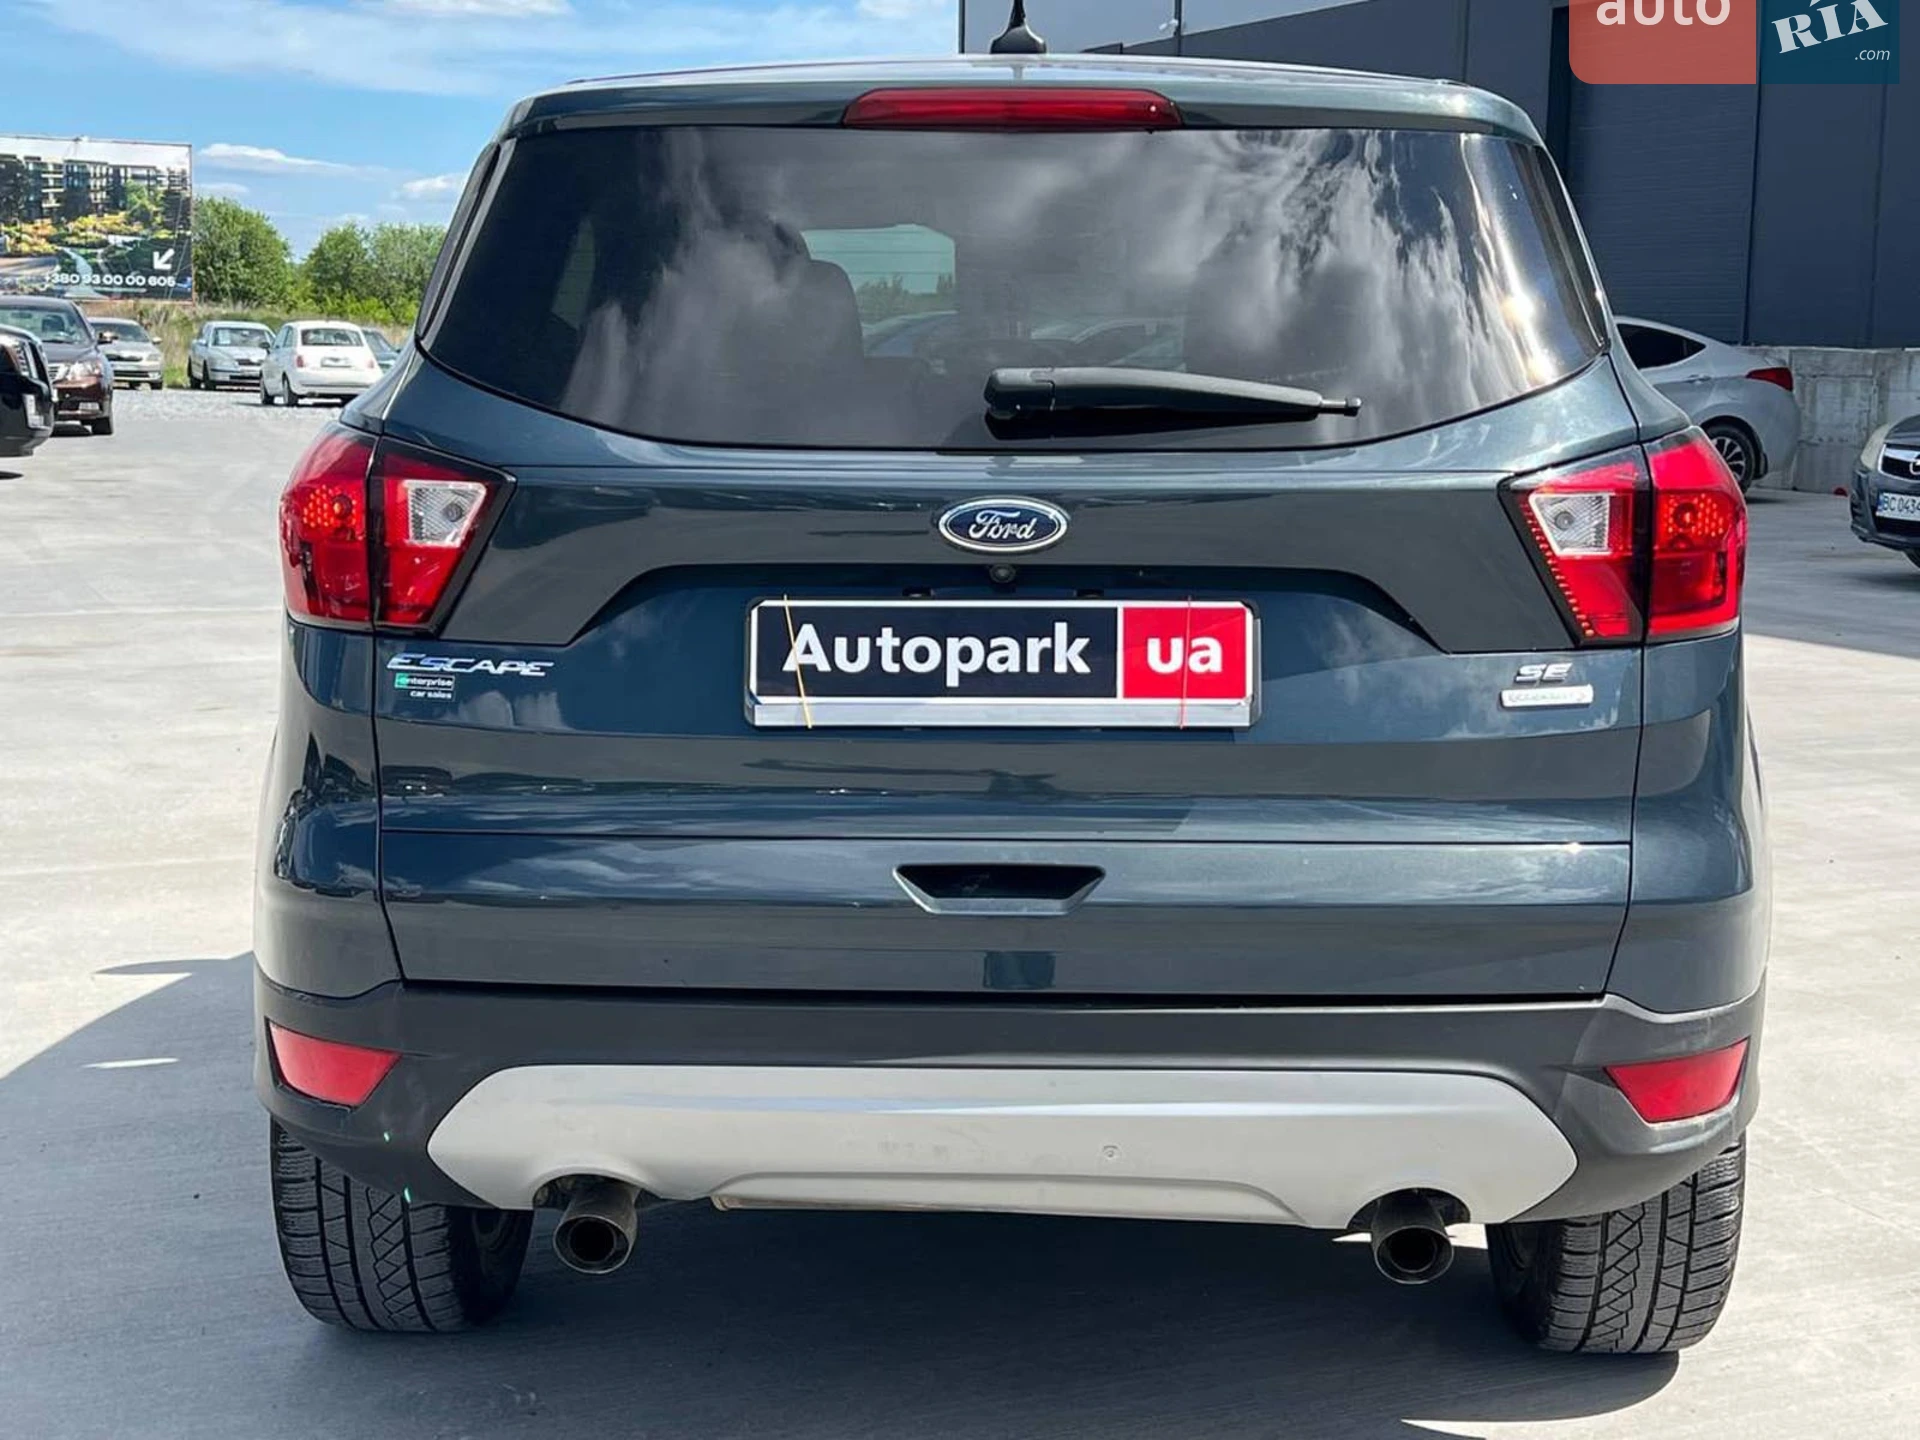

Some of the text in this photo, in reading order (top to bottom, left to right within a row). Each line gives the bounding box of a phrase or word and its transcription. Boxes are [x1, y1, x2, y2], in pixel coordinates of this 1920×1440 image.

[102, 274, 124, 286] 00
[125, 275, 146, 287] 00
[968, 509, 1037, 539] Ford
[386, 652, 554, 676] ESCAPE
[782, 622, 1222, 687] Autopark ua
[1516, 662, 1573, 682] SE
